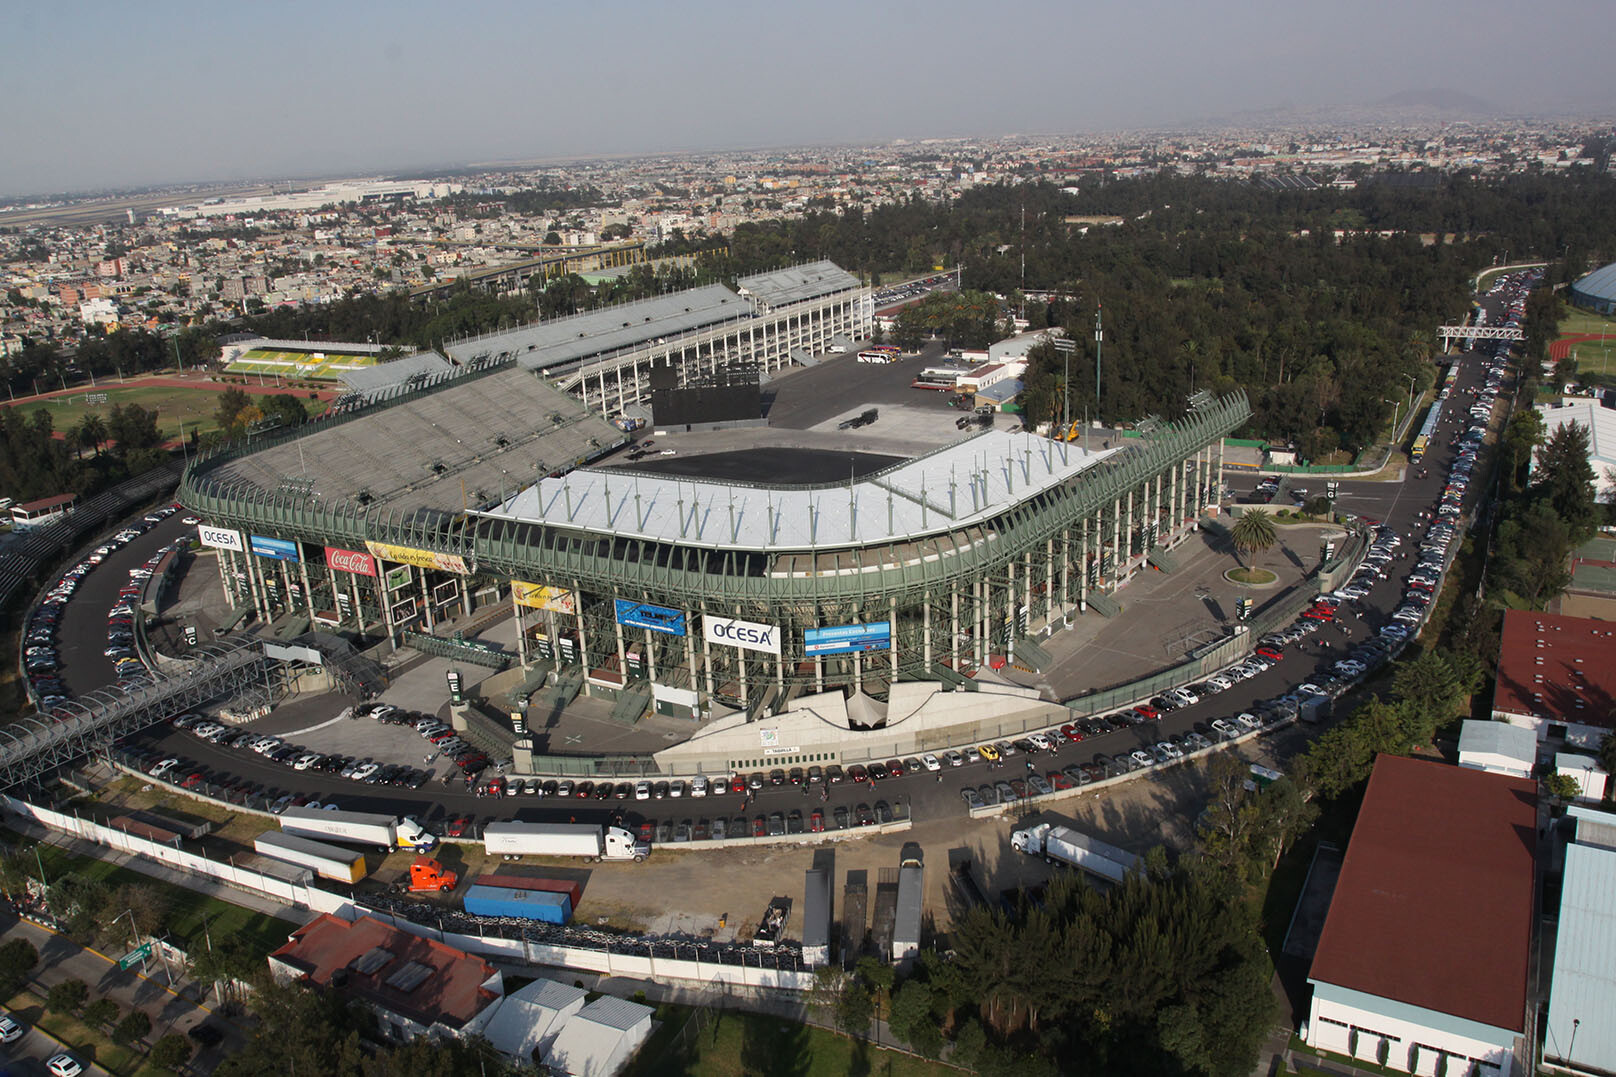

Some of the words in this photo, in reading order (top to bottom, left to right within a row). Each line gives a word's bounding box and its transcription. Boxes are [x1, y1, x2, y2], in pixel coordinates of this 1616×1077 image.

[204, 530, 237, 546] OCESA
[331, 550, 368, 572] Coca-Cola
[1244, 609, 1250, 618] F
[714, 624, 772, 646] OCESA
[188, 637, 196, 645] C
[450, 683, 459, 692] E
[514, 724, 522, 733] E
